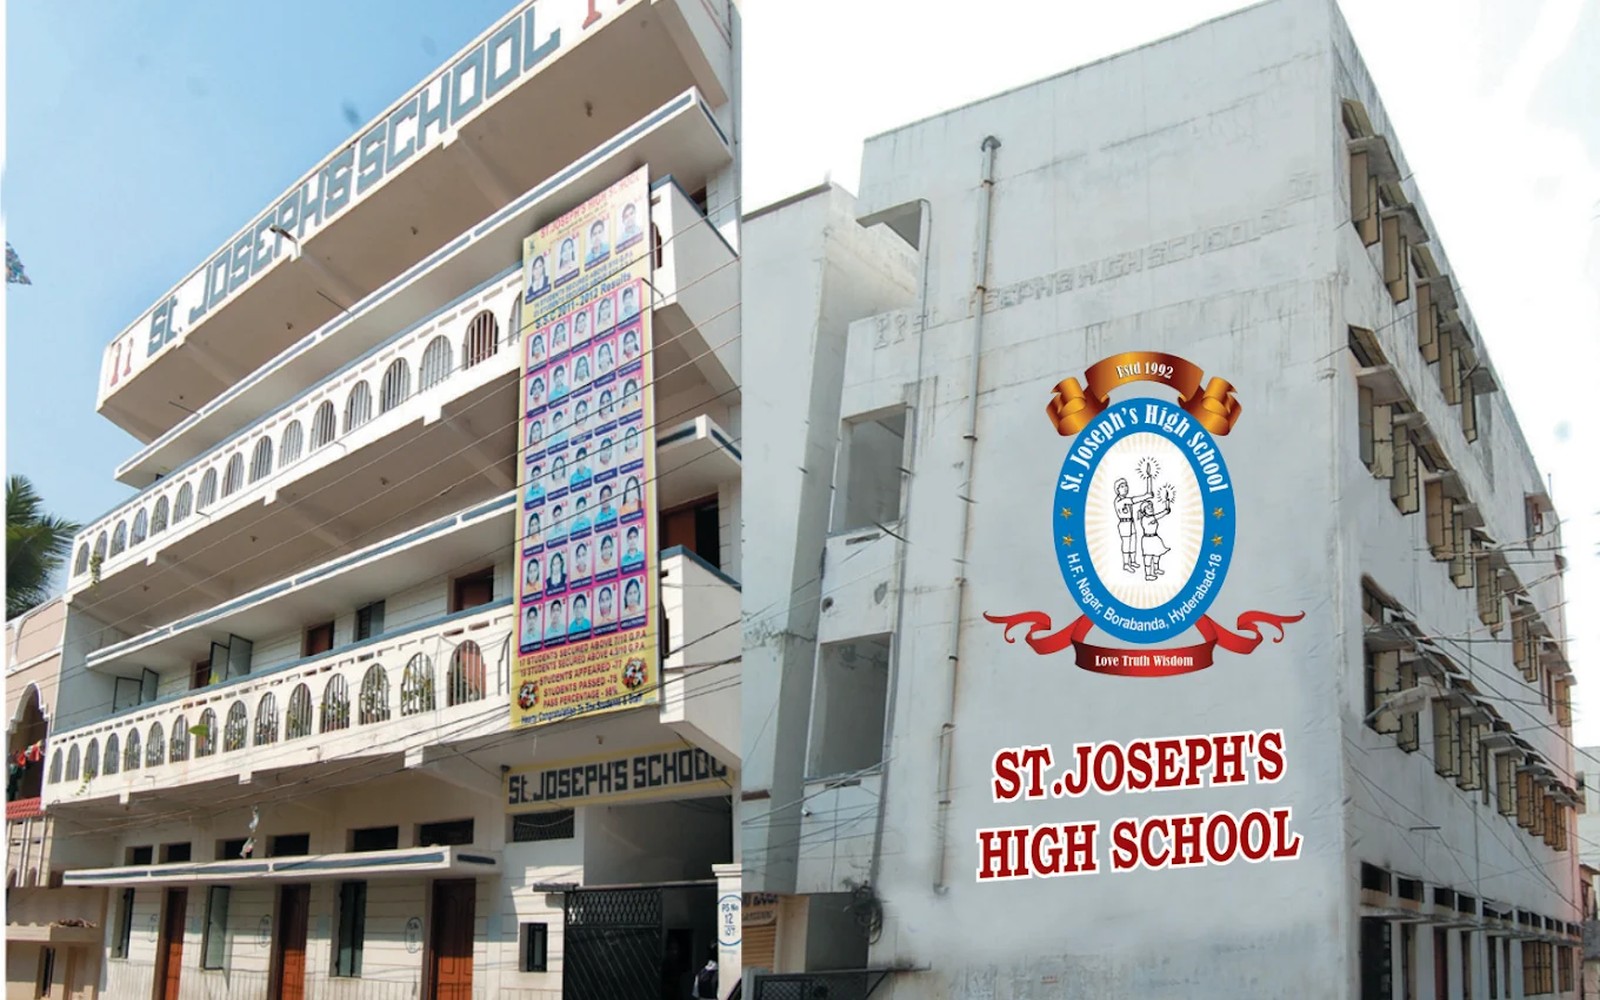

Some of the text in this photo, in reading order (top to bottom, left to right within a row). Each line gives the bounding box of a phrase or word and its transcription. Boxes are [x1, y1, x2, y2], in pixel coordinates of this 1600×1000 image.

[146, 295, 182, 358] St.
[356, 5, 561, 196] SCHOOL
[600, 272, 632, 295] Results
[527, 651, 558, 665] STUDENTS
[560, 643, 589, 657] SECURED
[590, 637, 613, 650] ABOVE
[527, 661, 557, 676] STUDENTS
[558, 653, 586, 669] SECURED
[587, 649, 609, 661] ABOVE
[539, 669, 573, 686] STUDENTS
[574, 661, 611, 677] APPEARED
[543, 682, 577, 697] STUDENTS
[579, 676, 605, 689] PASSED
[543, 697, 558, 709] PASS
[559, 688, 600, 705] PERCENTAGE
[633, 747, 727, 789] SCHOOL
